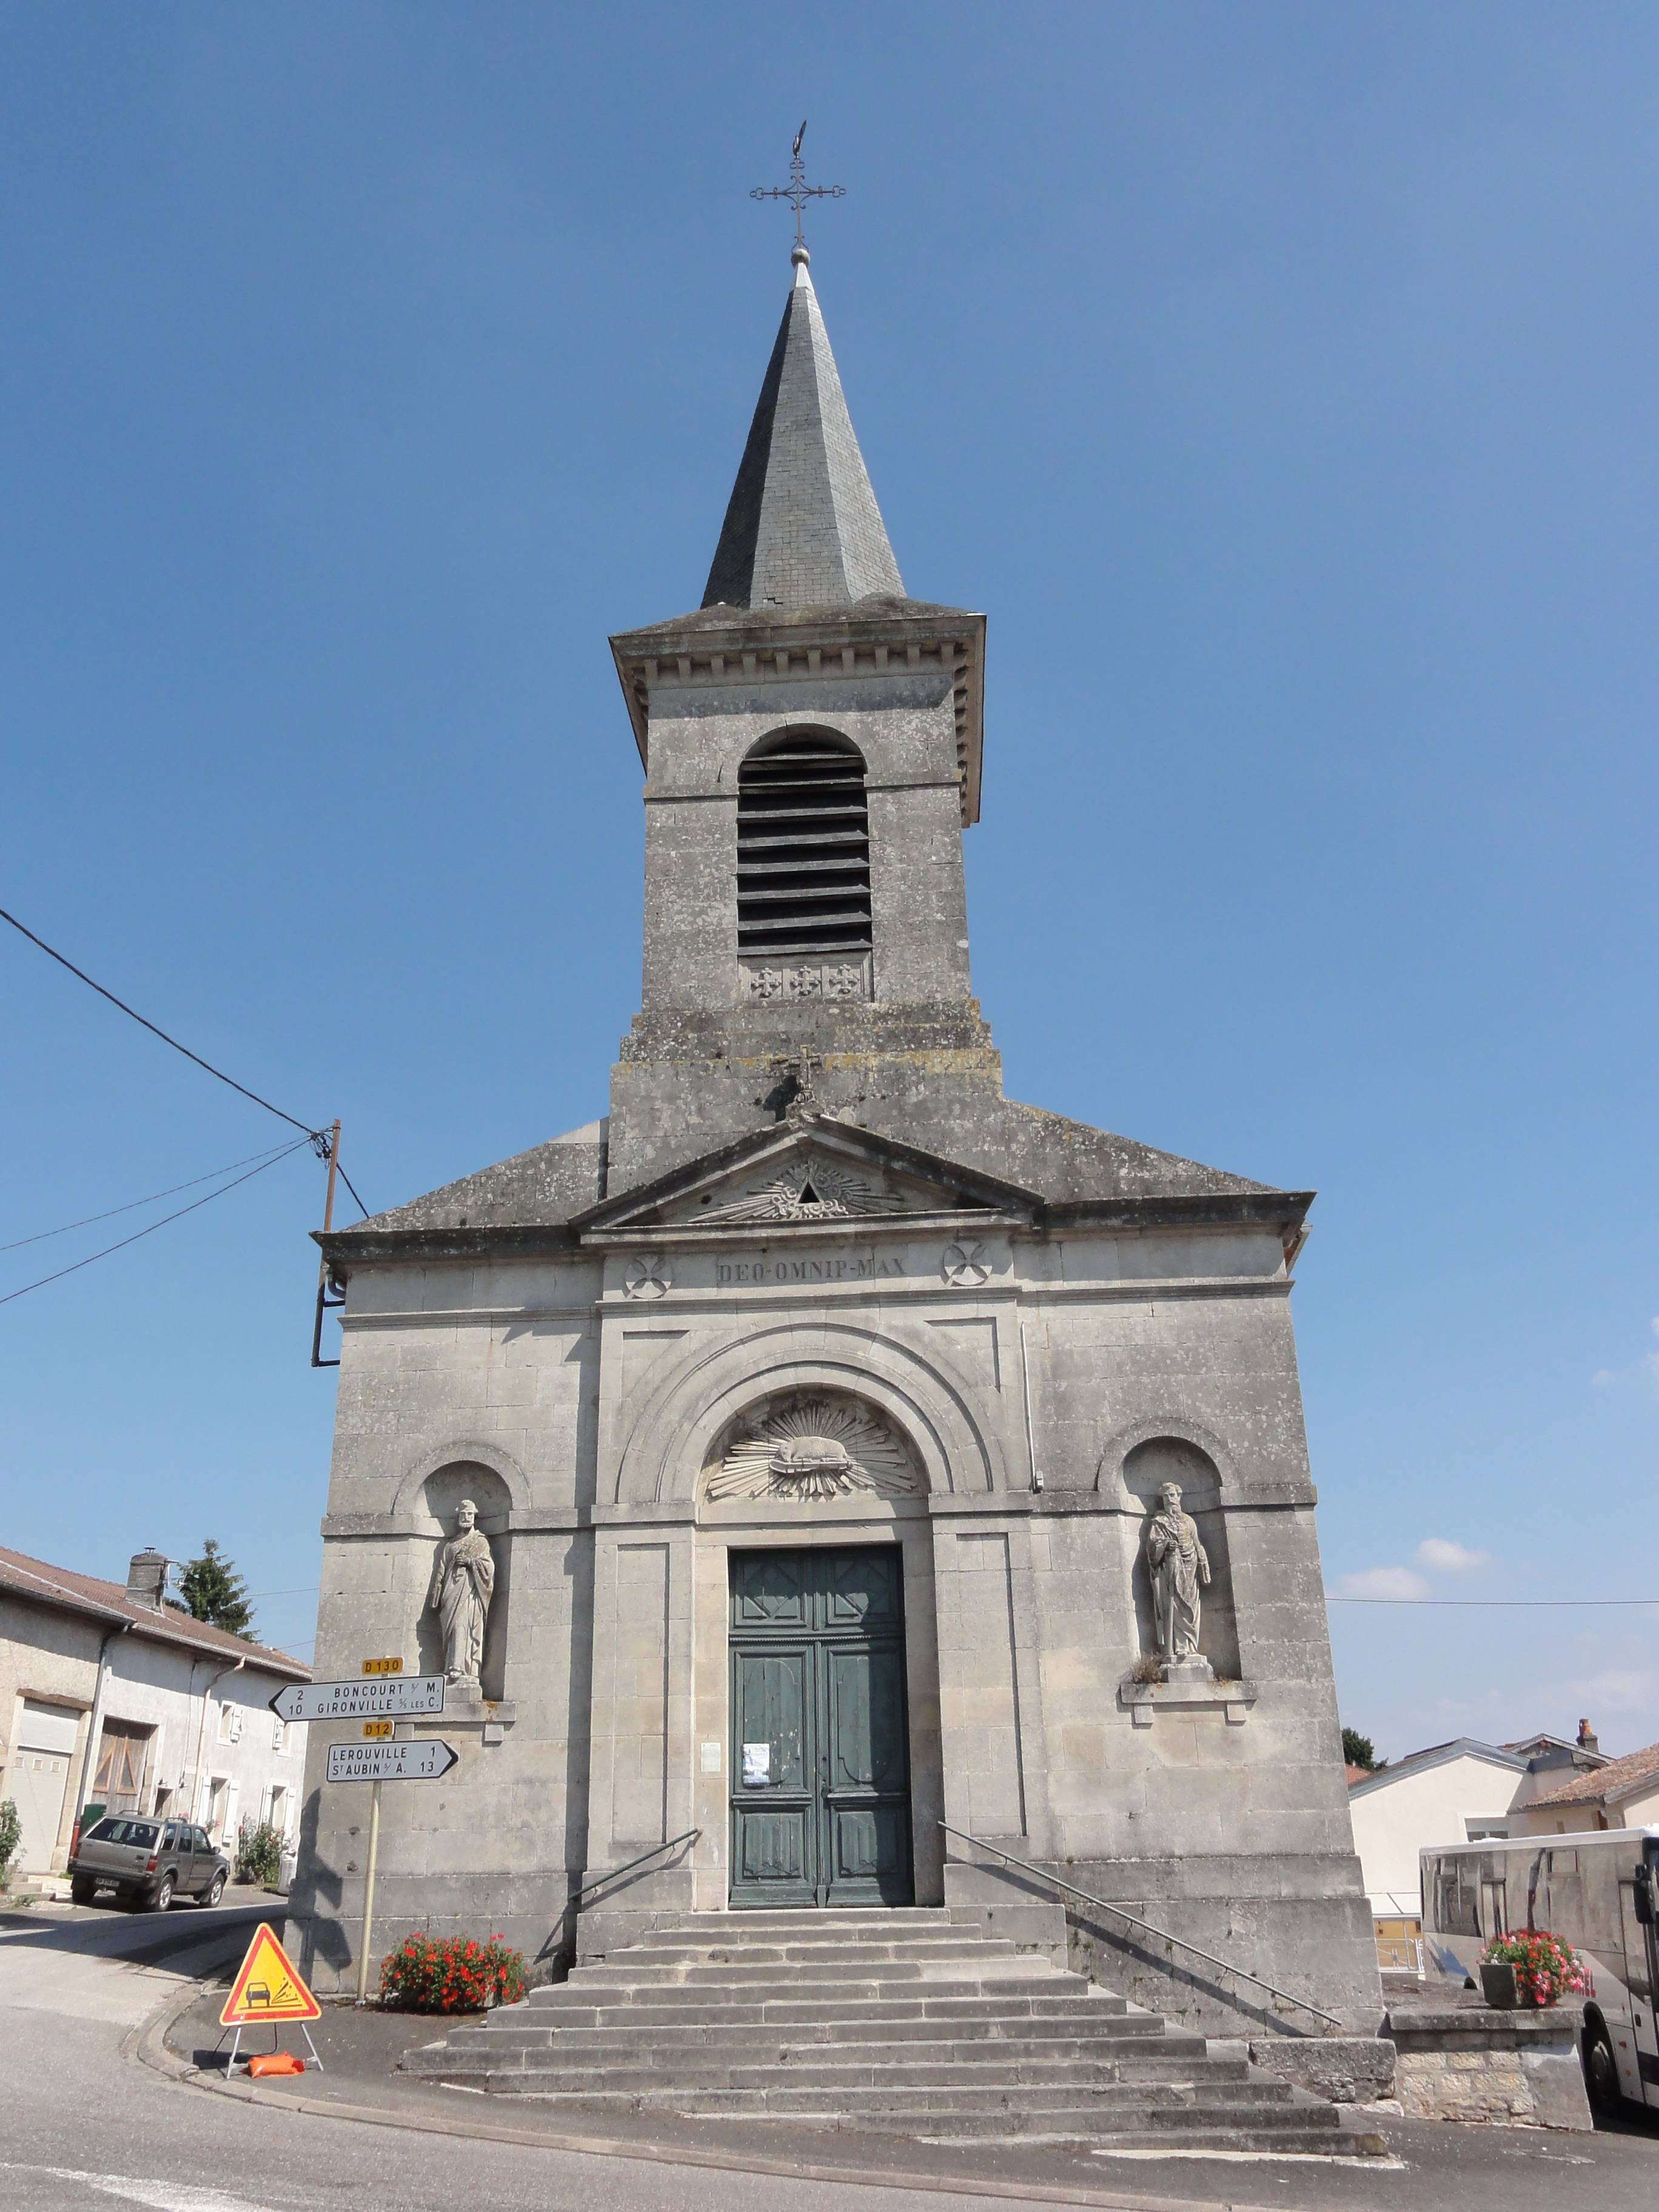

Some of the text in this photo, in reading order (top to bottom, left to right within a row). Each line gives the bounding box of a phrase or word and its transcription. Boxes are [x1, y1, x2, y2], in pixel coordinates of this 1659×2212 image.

[377, 1660, 399, 1672] 130
[297, 1689, 304, 1701] 2
[334, 1684, 404, 1698] BONCOURT
[426, 1682, 440, 1694] M.
[289, 1704, 303, 1715] 10
[317, 1699, 393, 1714] GIRONVILLE
[332, 1746, 436, 1761] LEROUVILLE 1
[345, 1763, 380, 1775] AUBIN
[420, 1761, 434, 1772] 13
